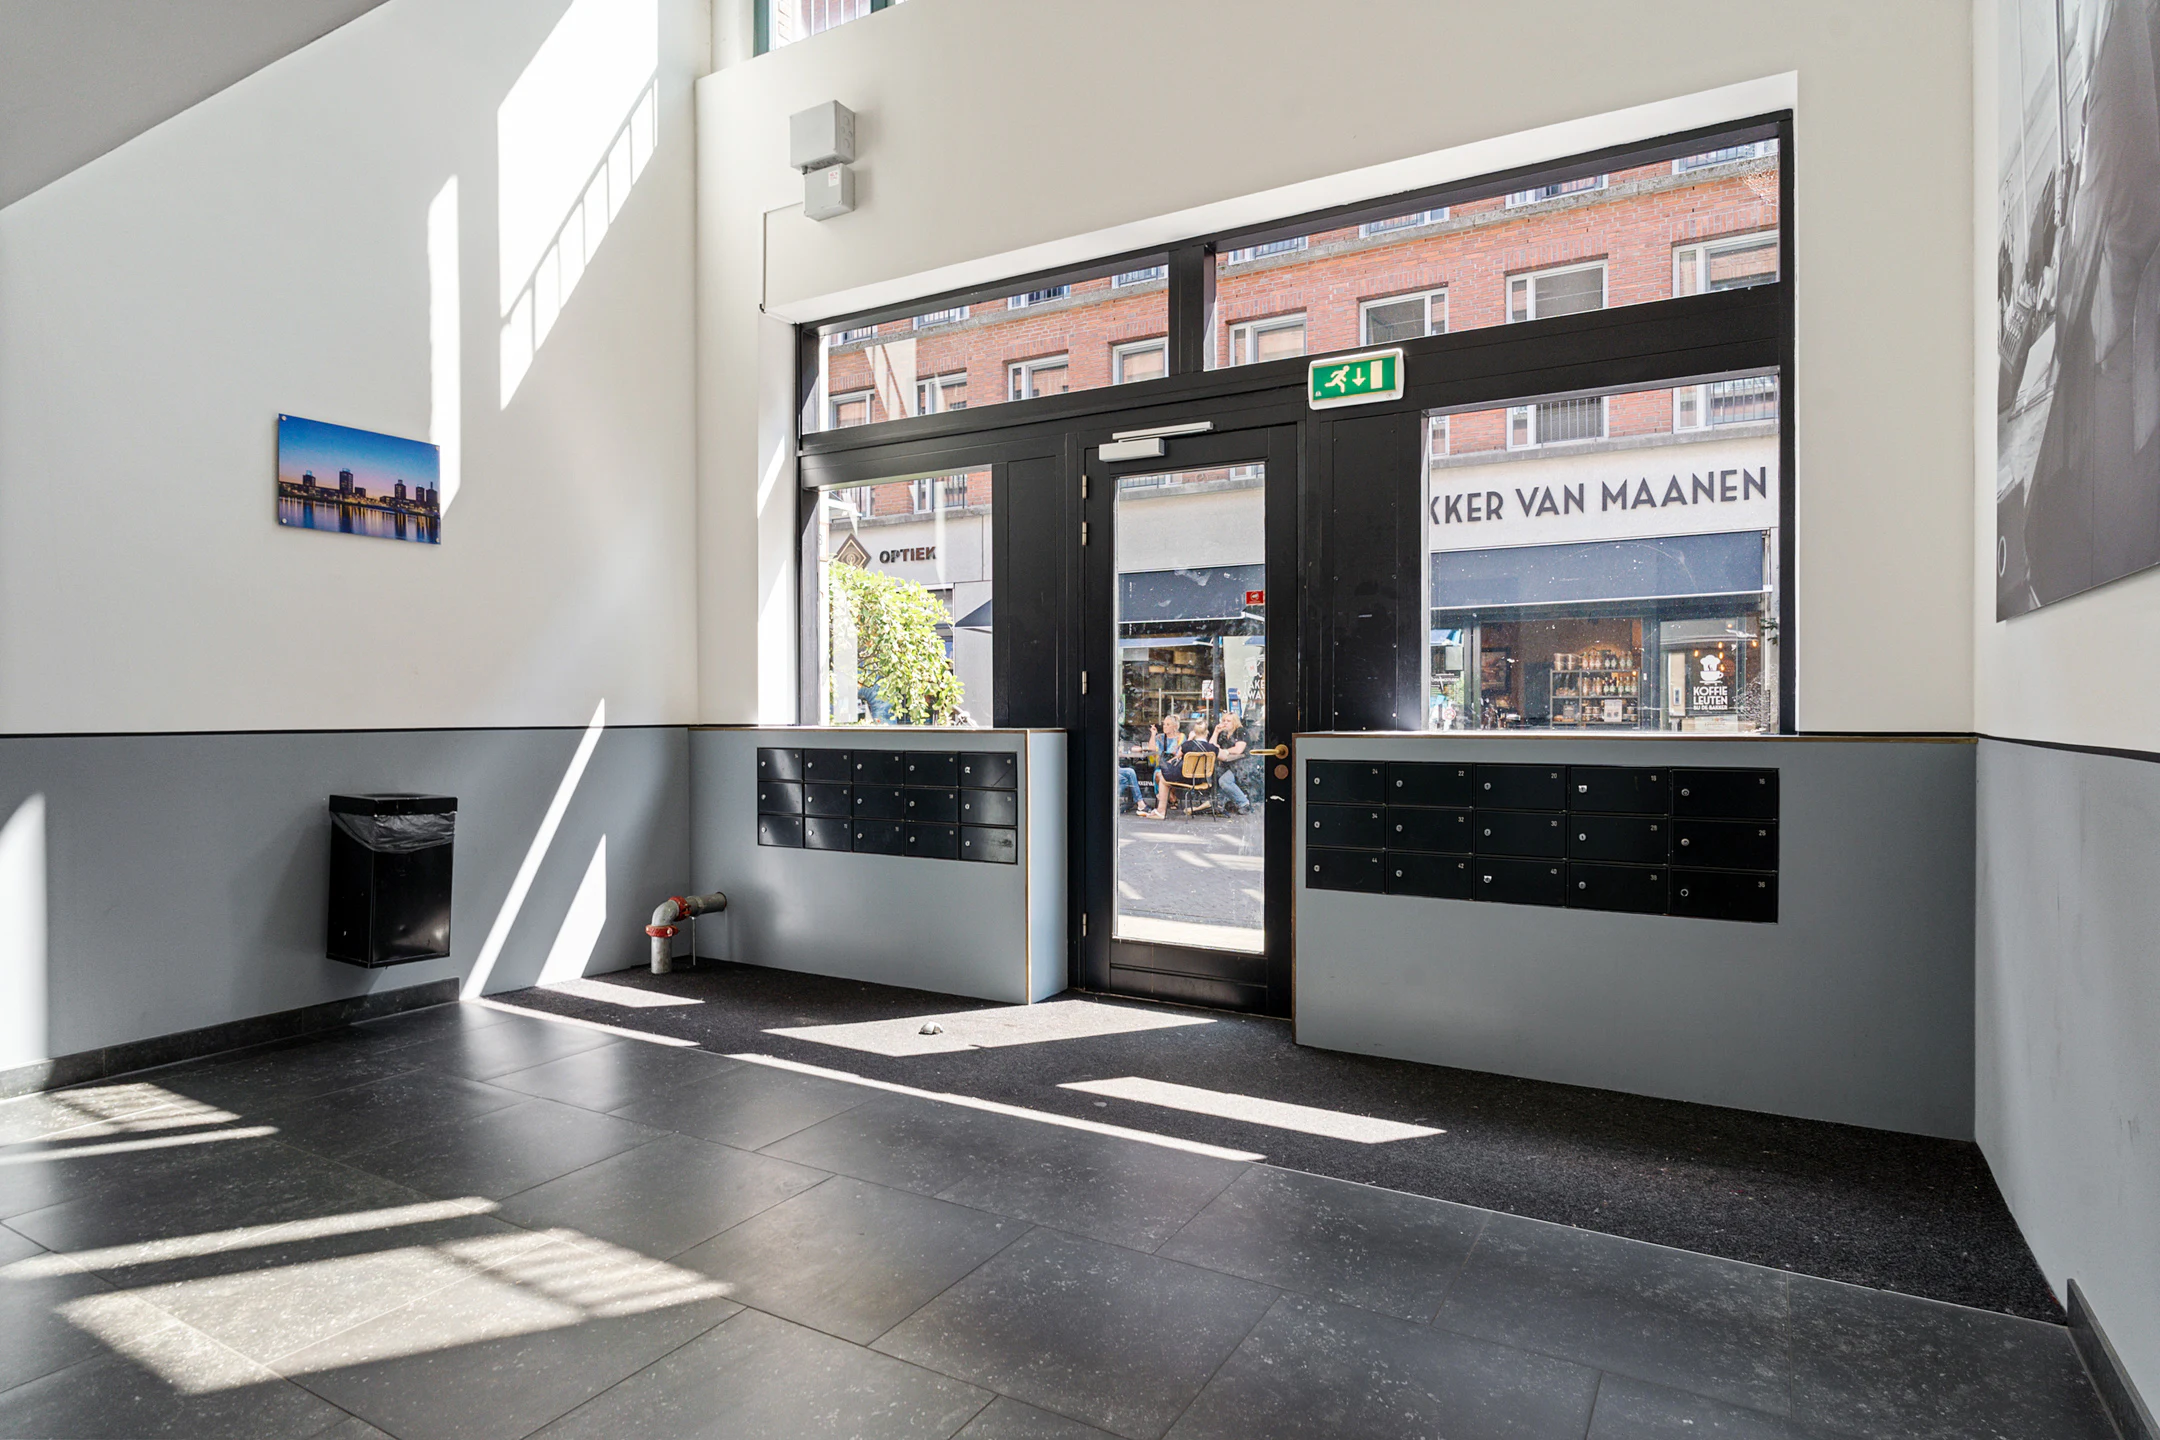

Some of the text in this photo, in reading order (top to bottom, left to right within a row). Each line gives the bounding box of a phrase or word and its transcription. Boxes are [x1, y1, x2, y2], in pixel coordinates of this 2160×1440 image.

[1515, 483, 1584, 517] VAN
[1601, 466, 1767, 511] MAANEN
[879, 546, 937, 564] OPTIEK
[1693, 686, 1728, 696] KOFFIE
[1693, 696, 1728, 705] LEUTEN
